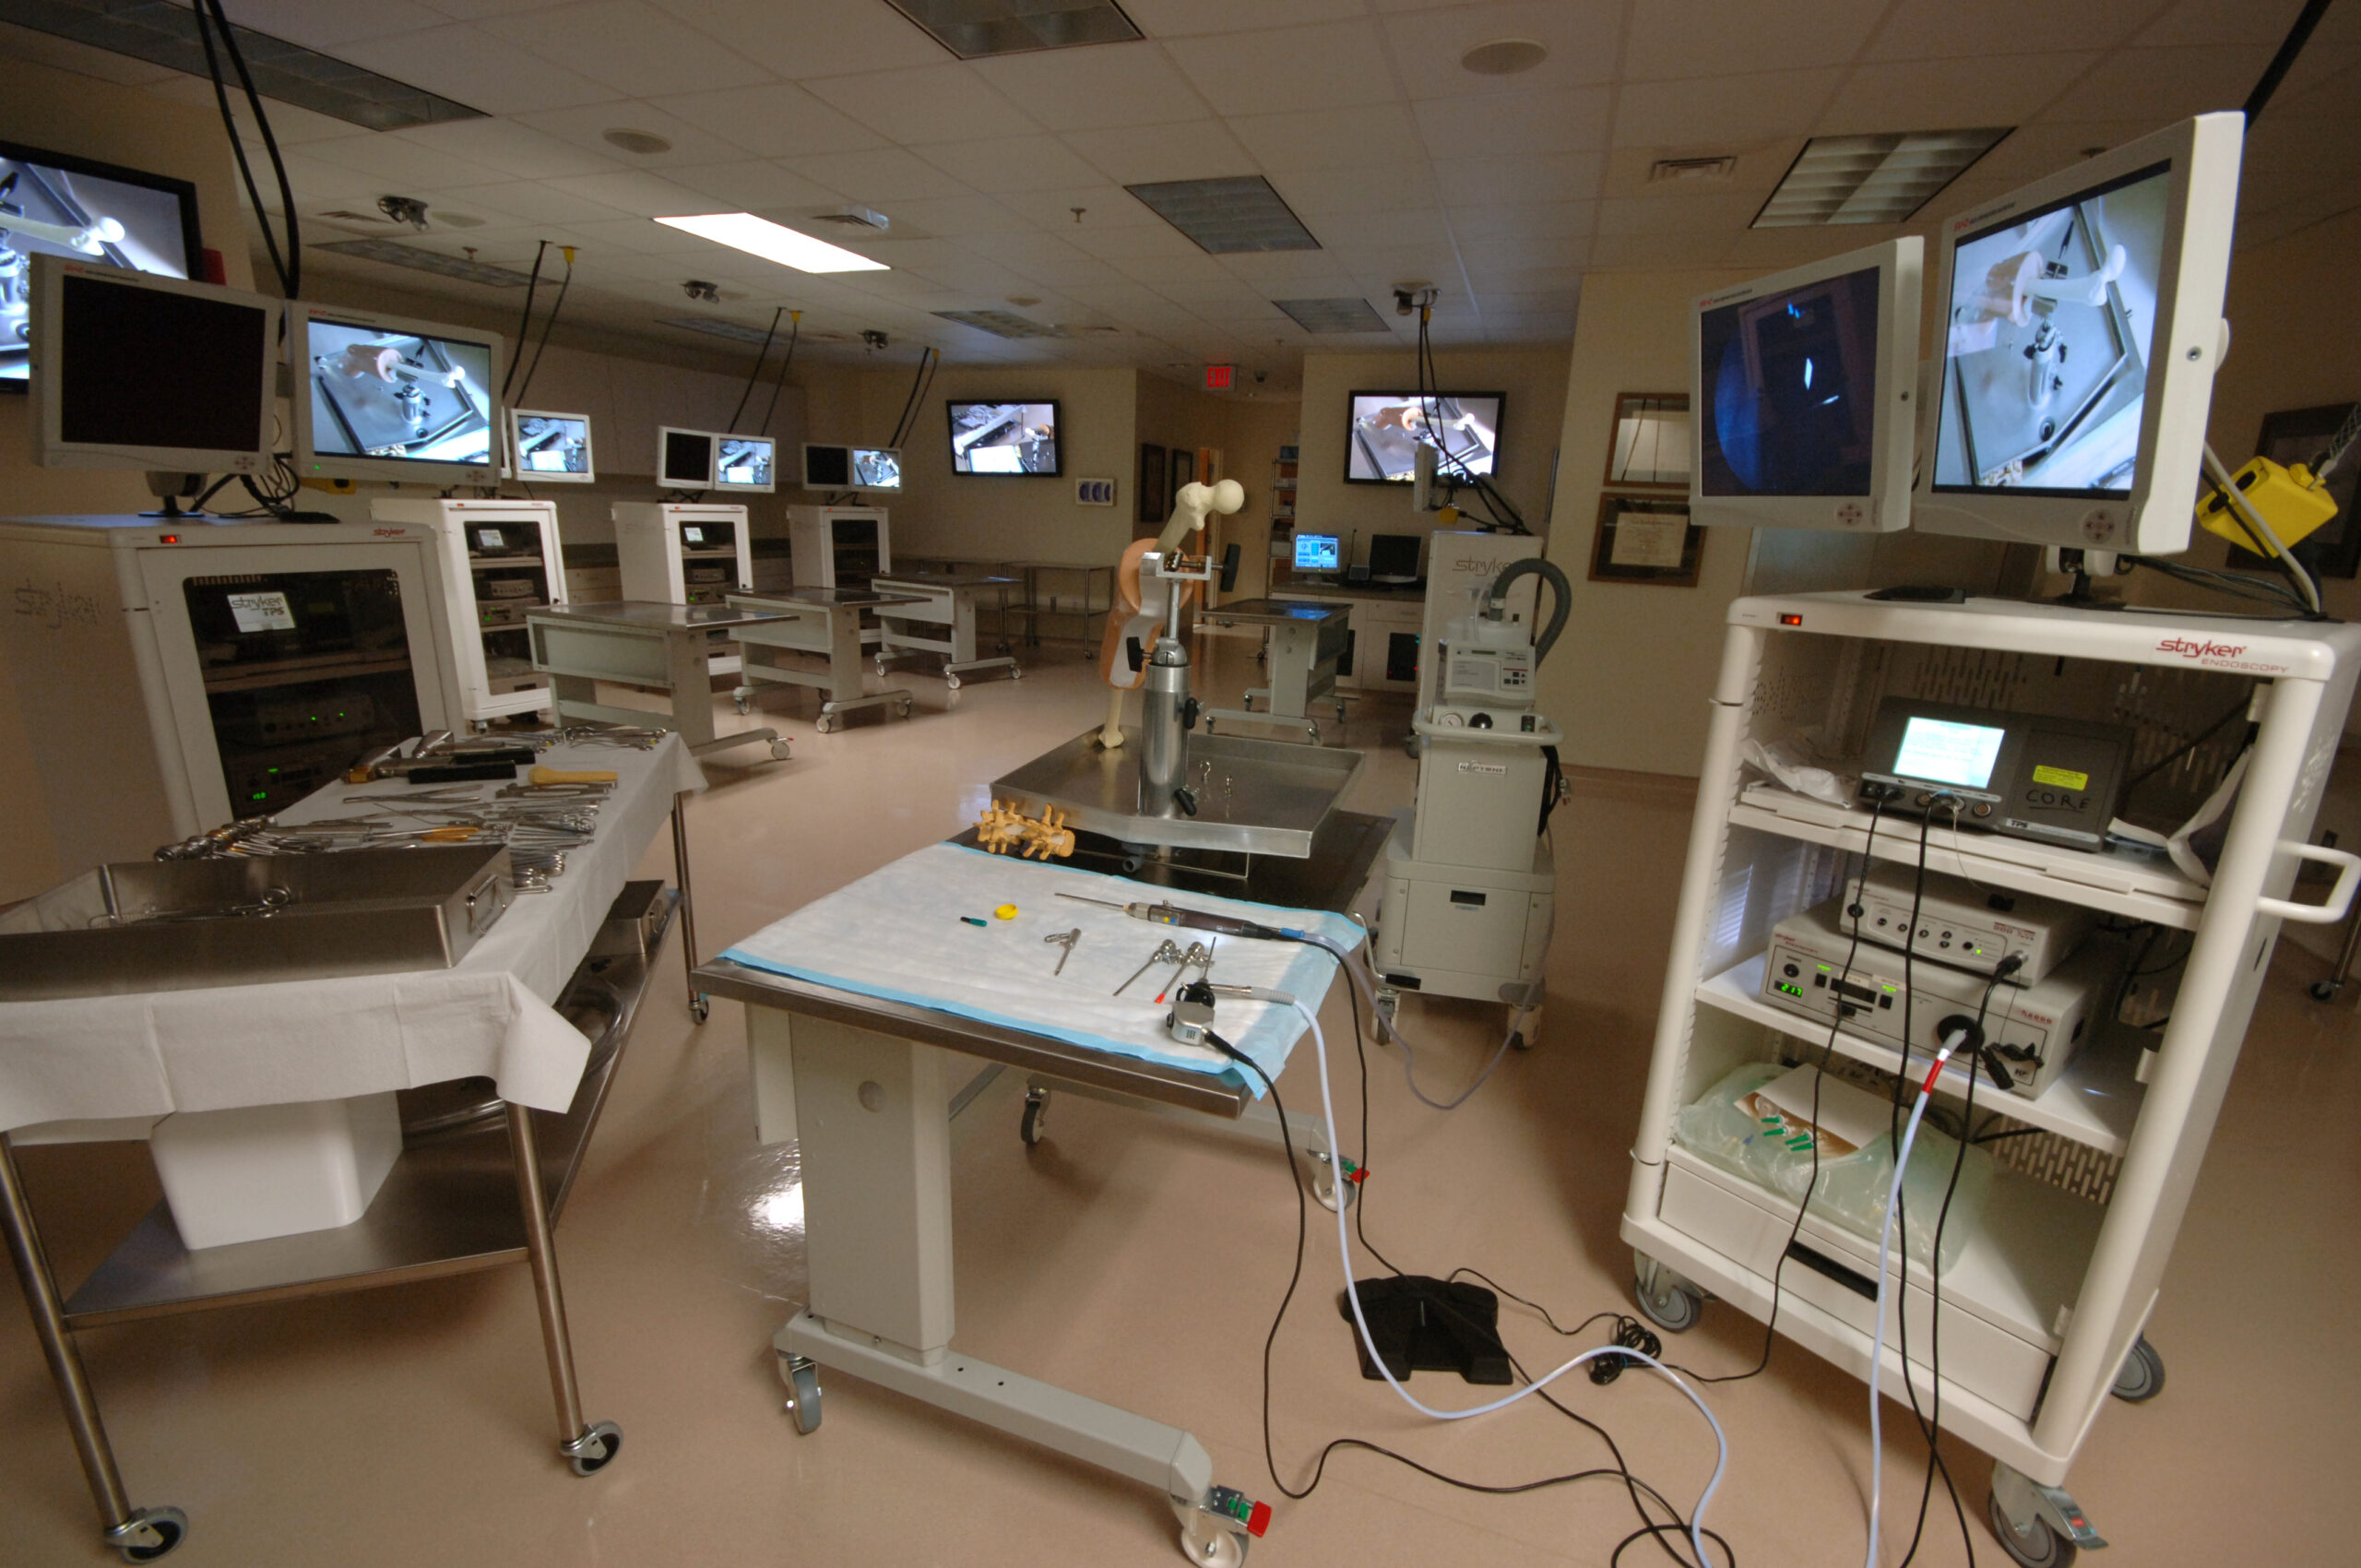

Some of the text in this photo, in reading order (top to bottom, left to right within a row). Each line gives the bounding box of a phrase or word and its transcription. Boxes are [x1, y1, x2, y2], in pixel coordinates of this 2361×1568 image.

[1207, 366, 1232, 388] EXIT
[1452, 556, 1511, 576] stryke
[231, 595, 283, 611] stryker
[262, 608, 284, 617] TPS
[2155, 637, 2247, 658] stryker
[2201, 658, 2289, 673] ENDOSCOPY
[2025, 789, 2091, 810] CORE
